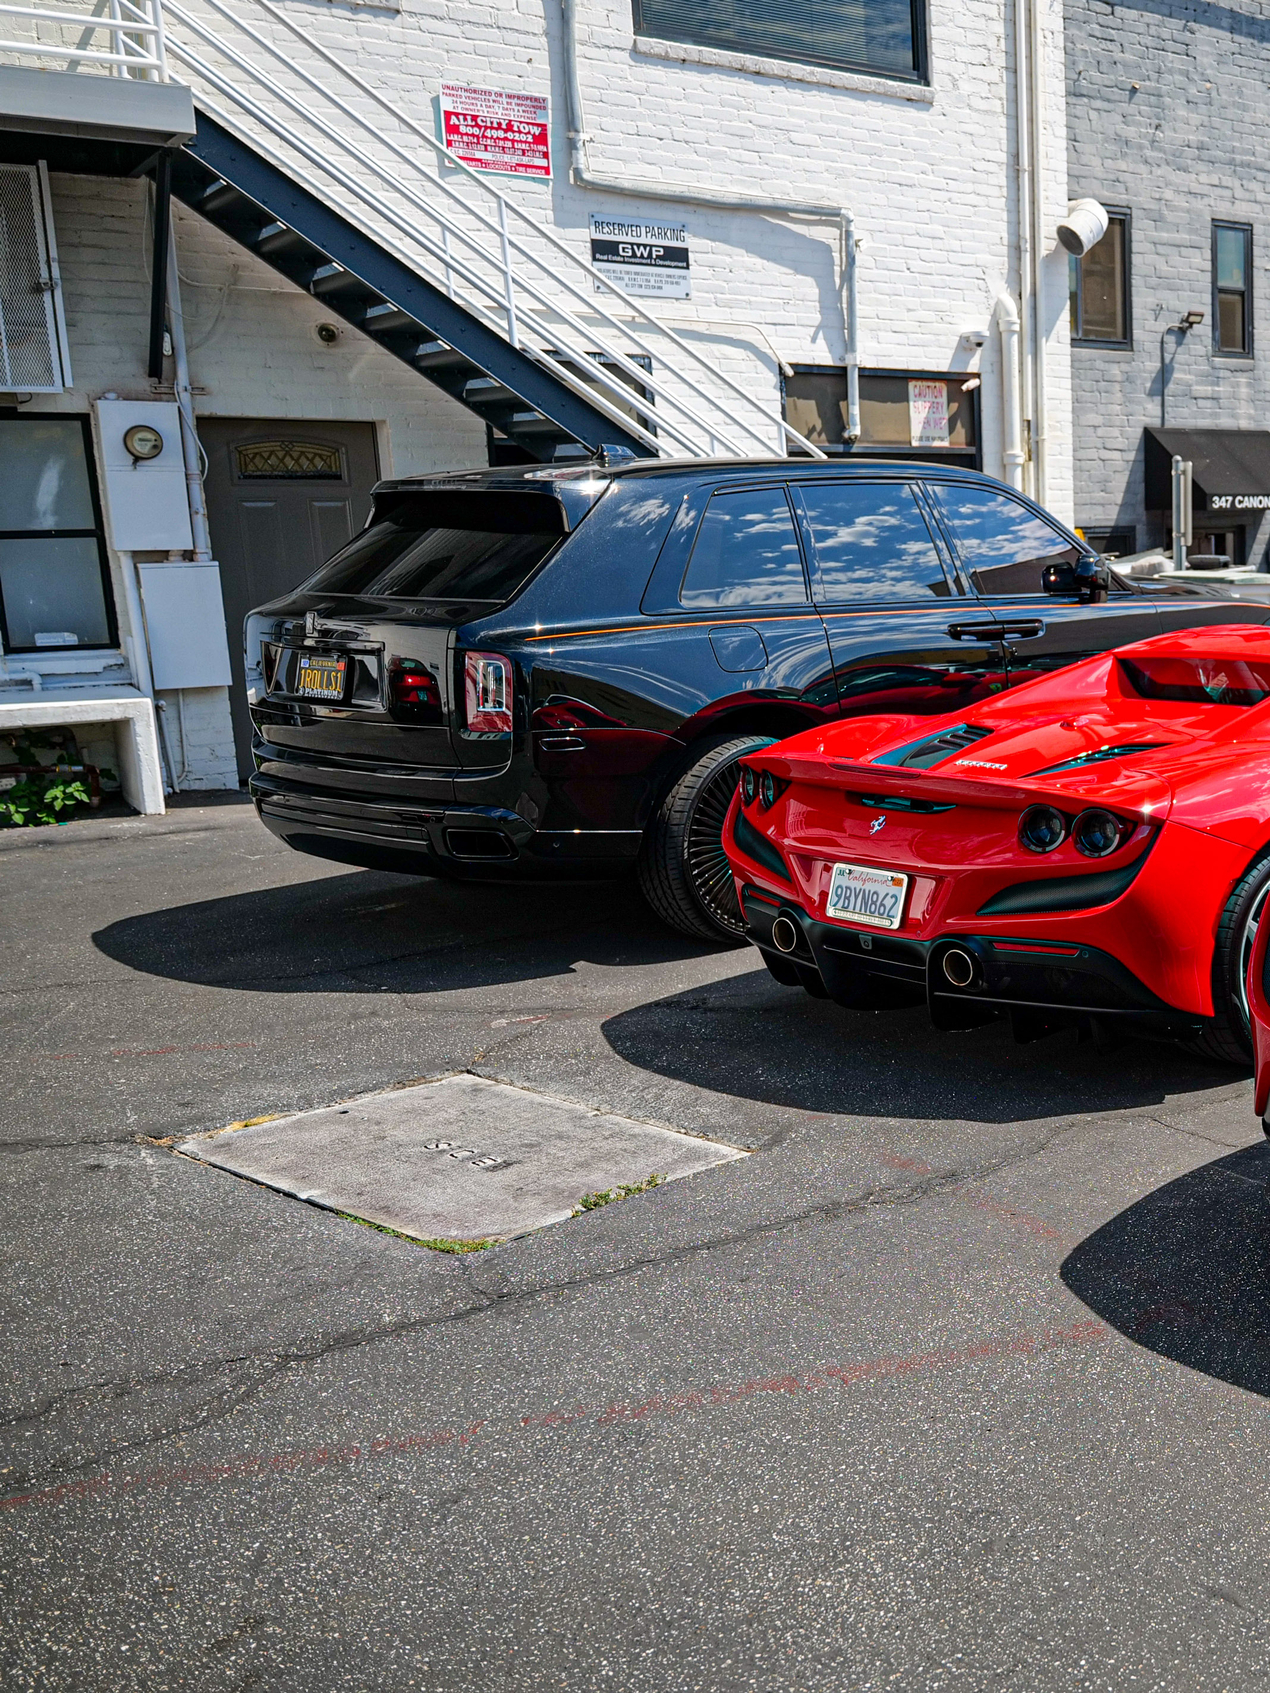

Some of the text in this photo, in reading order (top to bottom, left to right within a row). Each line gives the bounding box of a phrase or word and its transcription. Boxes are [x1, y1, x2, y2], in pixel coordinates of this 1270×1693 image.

[442, 84, 492, 98] UNAUTHORIZED
[505, 93, 547, 104] IMPROPERLY
[442, 91, 463, 100] PARKED
[464, 94, 491, 104] VEHICLES
[514, 102, 547, 111] IMPOUNDED
[459, 100, 478, 108] HOURS
[460, 106, 485, 114] OWNER'S
[513, 113, 537, 121] EXPENSE
[450, 114, 542, 136] ALL CITY TOW
[459, 124, 534, 142] 800/498-0202
[486, 162, 510, 171] LOCKOUTS
[594, 220, 686, 242] RESERVED PARKING
[618, 243, 664, 258] GWP
[608, 254, 624, 262] Estate
[625, 256, 651, 264] Investment
[656, 259, 687, 268] Development
[914, 384, 943, 398] CAUTION
[1212, 496, 1234, 508] 347
[299, 669, 342, 692] 1ROLLS1
[848, 870, 892, 887] California
[832, 884, 898, 918] 9BYN862
